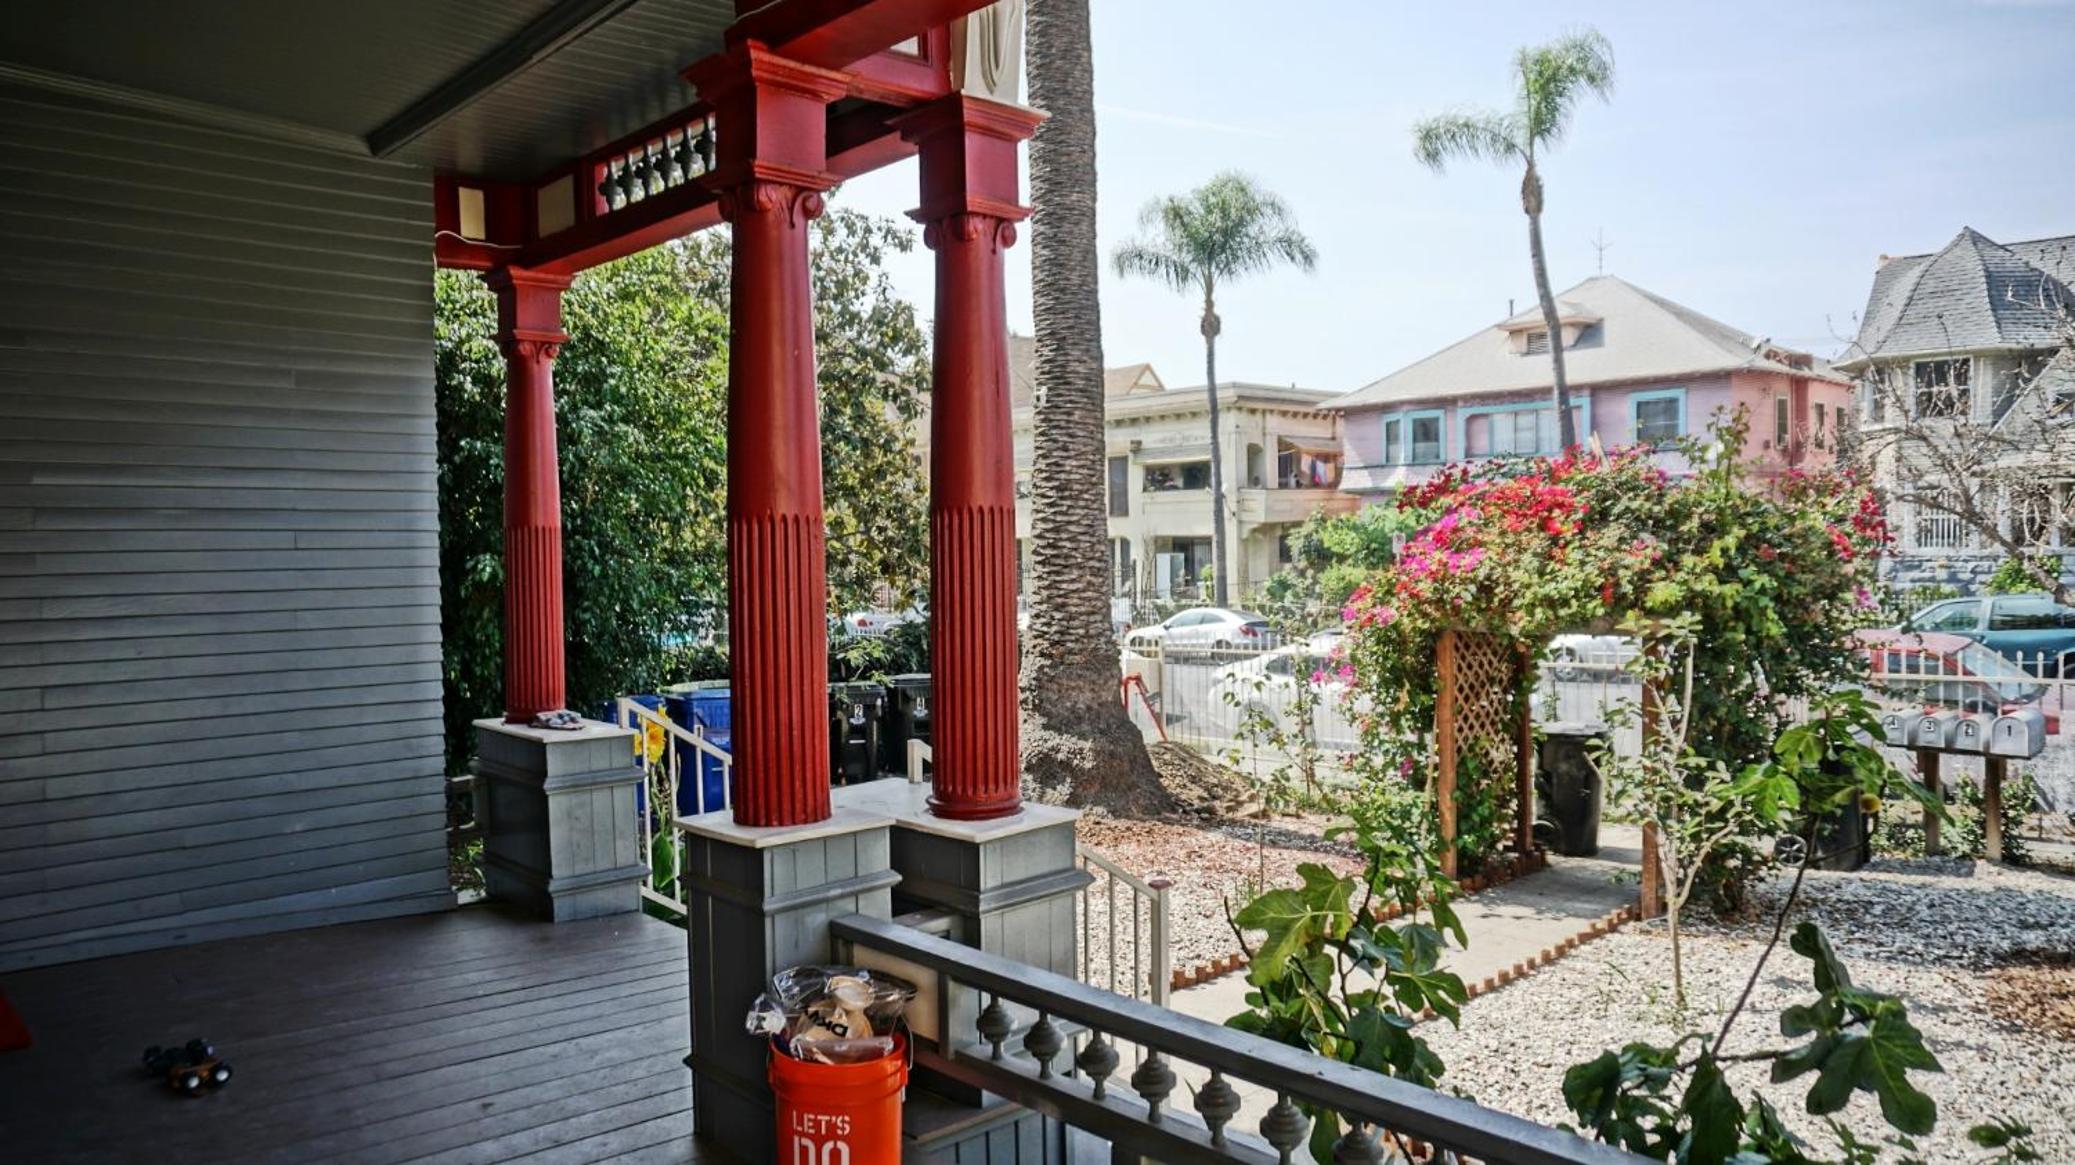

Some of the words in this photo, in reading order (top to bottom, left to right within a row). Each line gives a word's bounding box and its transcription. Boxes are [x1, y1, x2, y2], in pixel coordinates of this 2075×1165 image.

[2006, 725, 2012, 737] 1
[793, 1110, 851, 1136] LET'S
[793, 1135, 850, 1165] DO
